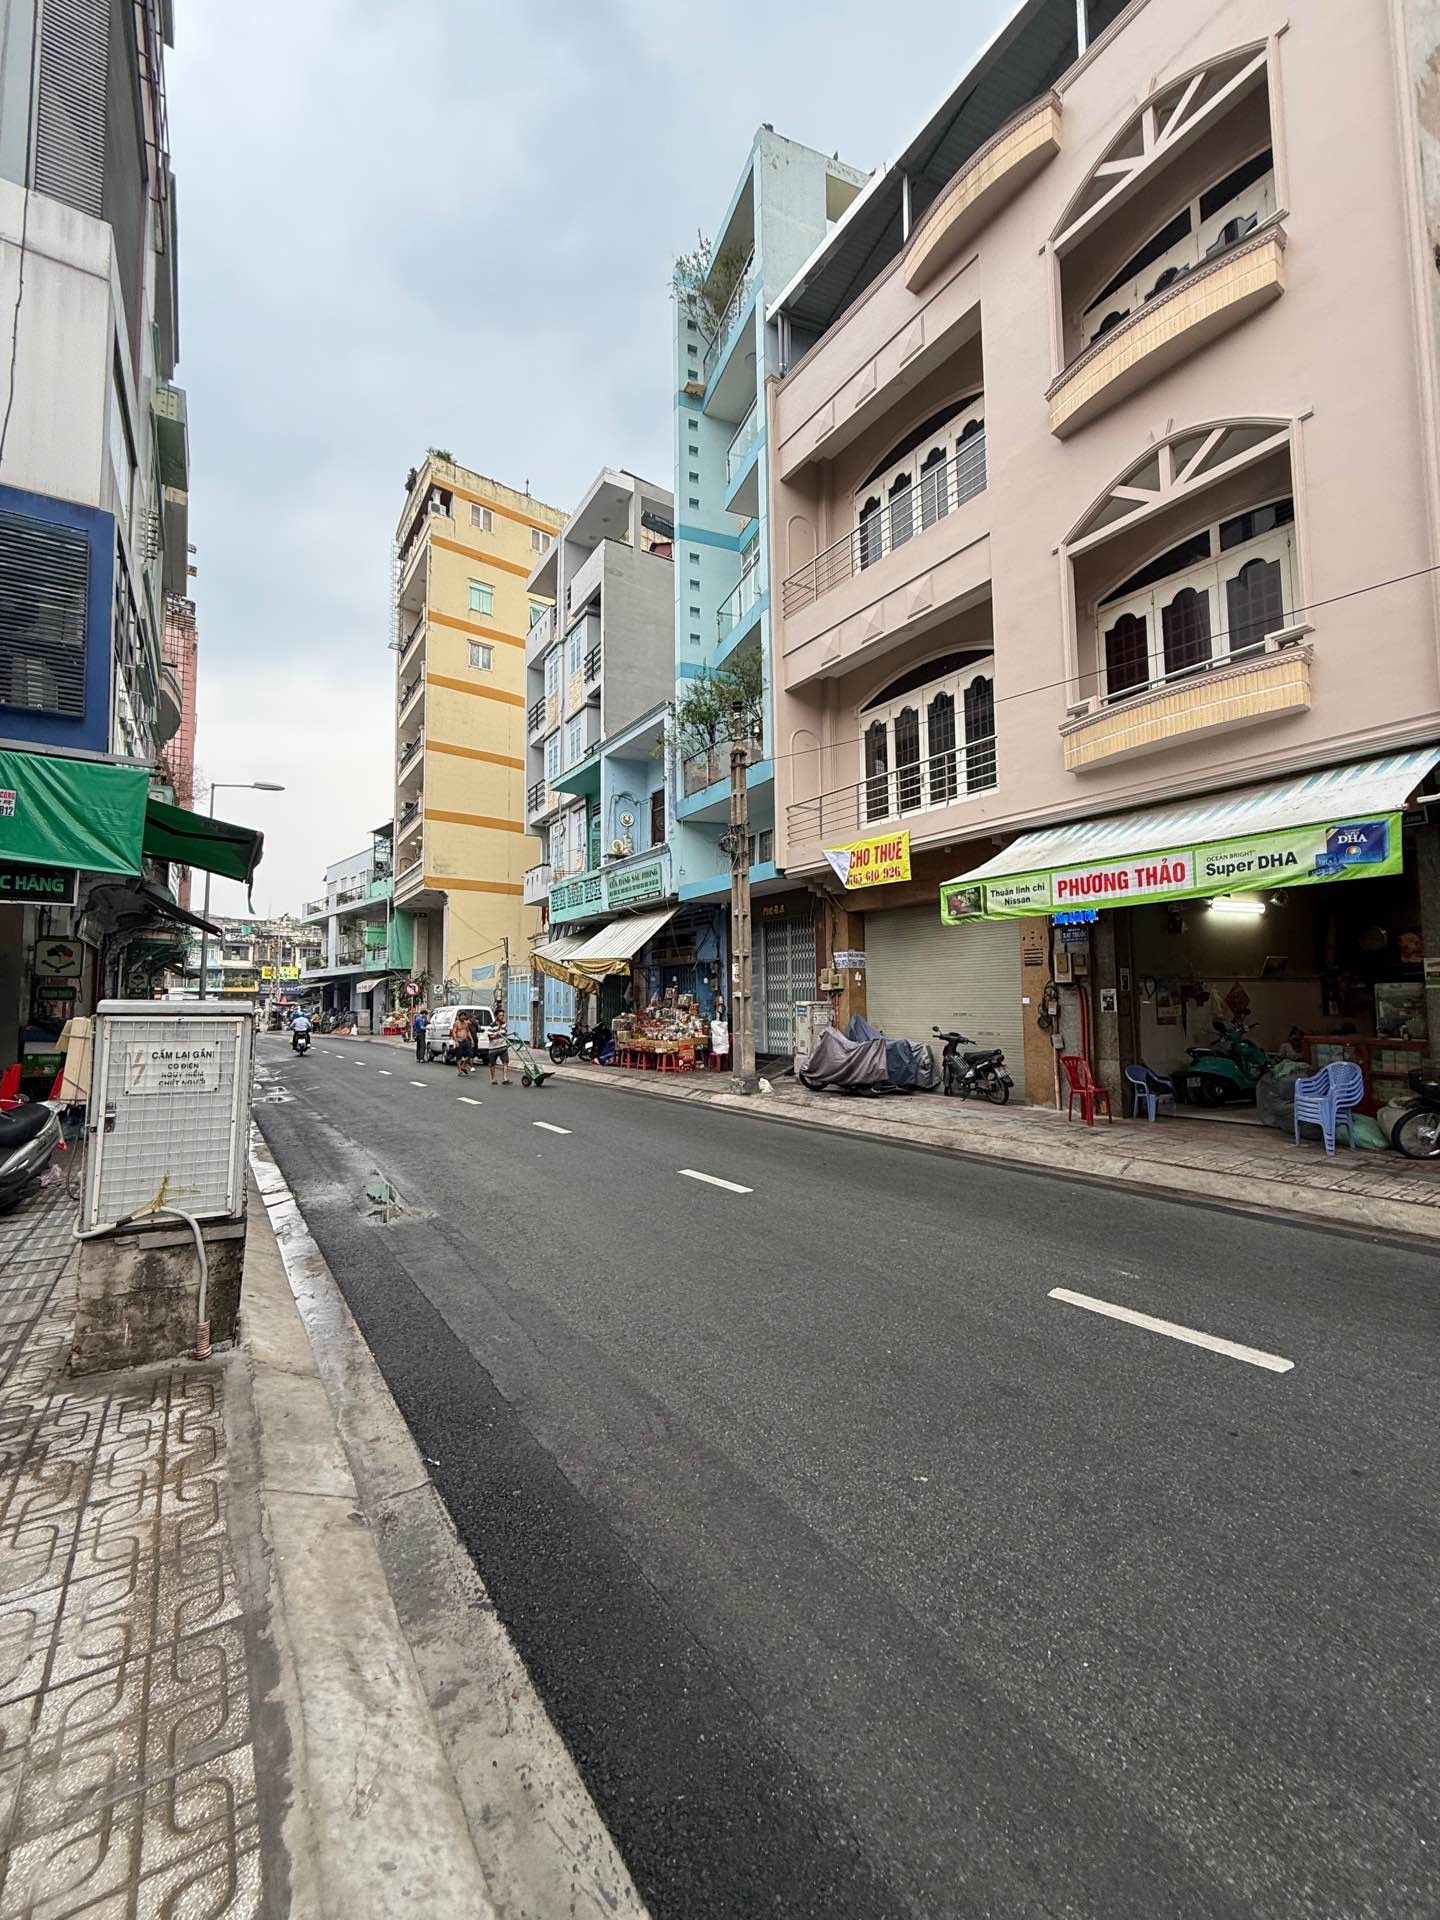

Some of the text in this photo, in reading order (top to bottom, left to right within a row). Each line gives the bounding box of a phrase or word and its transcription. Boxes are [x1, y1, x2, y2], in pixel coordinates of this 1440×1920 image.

[1337, 833, 1368, 844] DHA
[849, 836, 903, 869] CHO THUÊ
[1206, 850, 1254, 863] OCEAN BRIGHT
[1206, 851, 1298, 877] Super DHA
[1057, 858, 1186, 898] PHƯƠNG THẢO
[1015, 885, 1031, 895] linh
[1032, 882, 1046, 892] chi
[1004, 897, 1031, 906] Nissan
